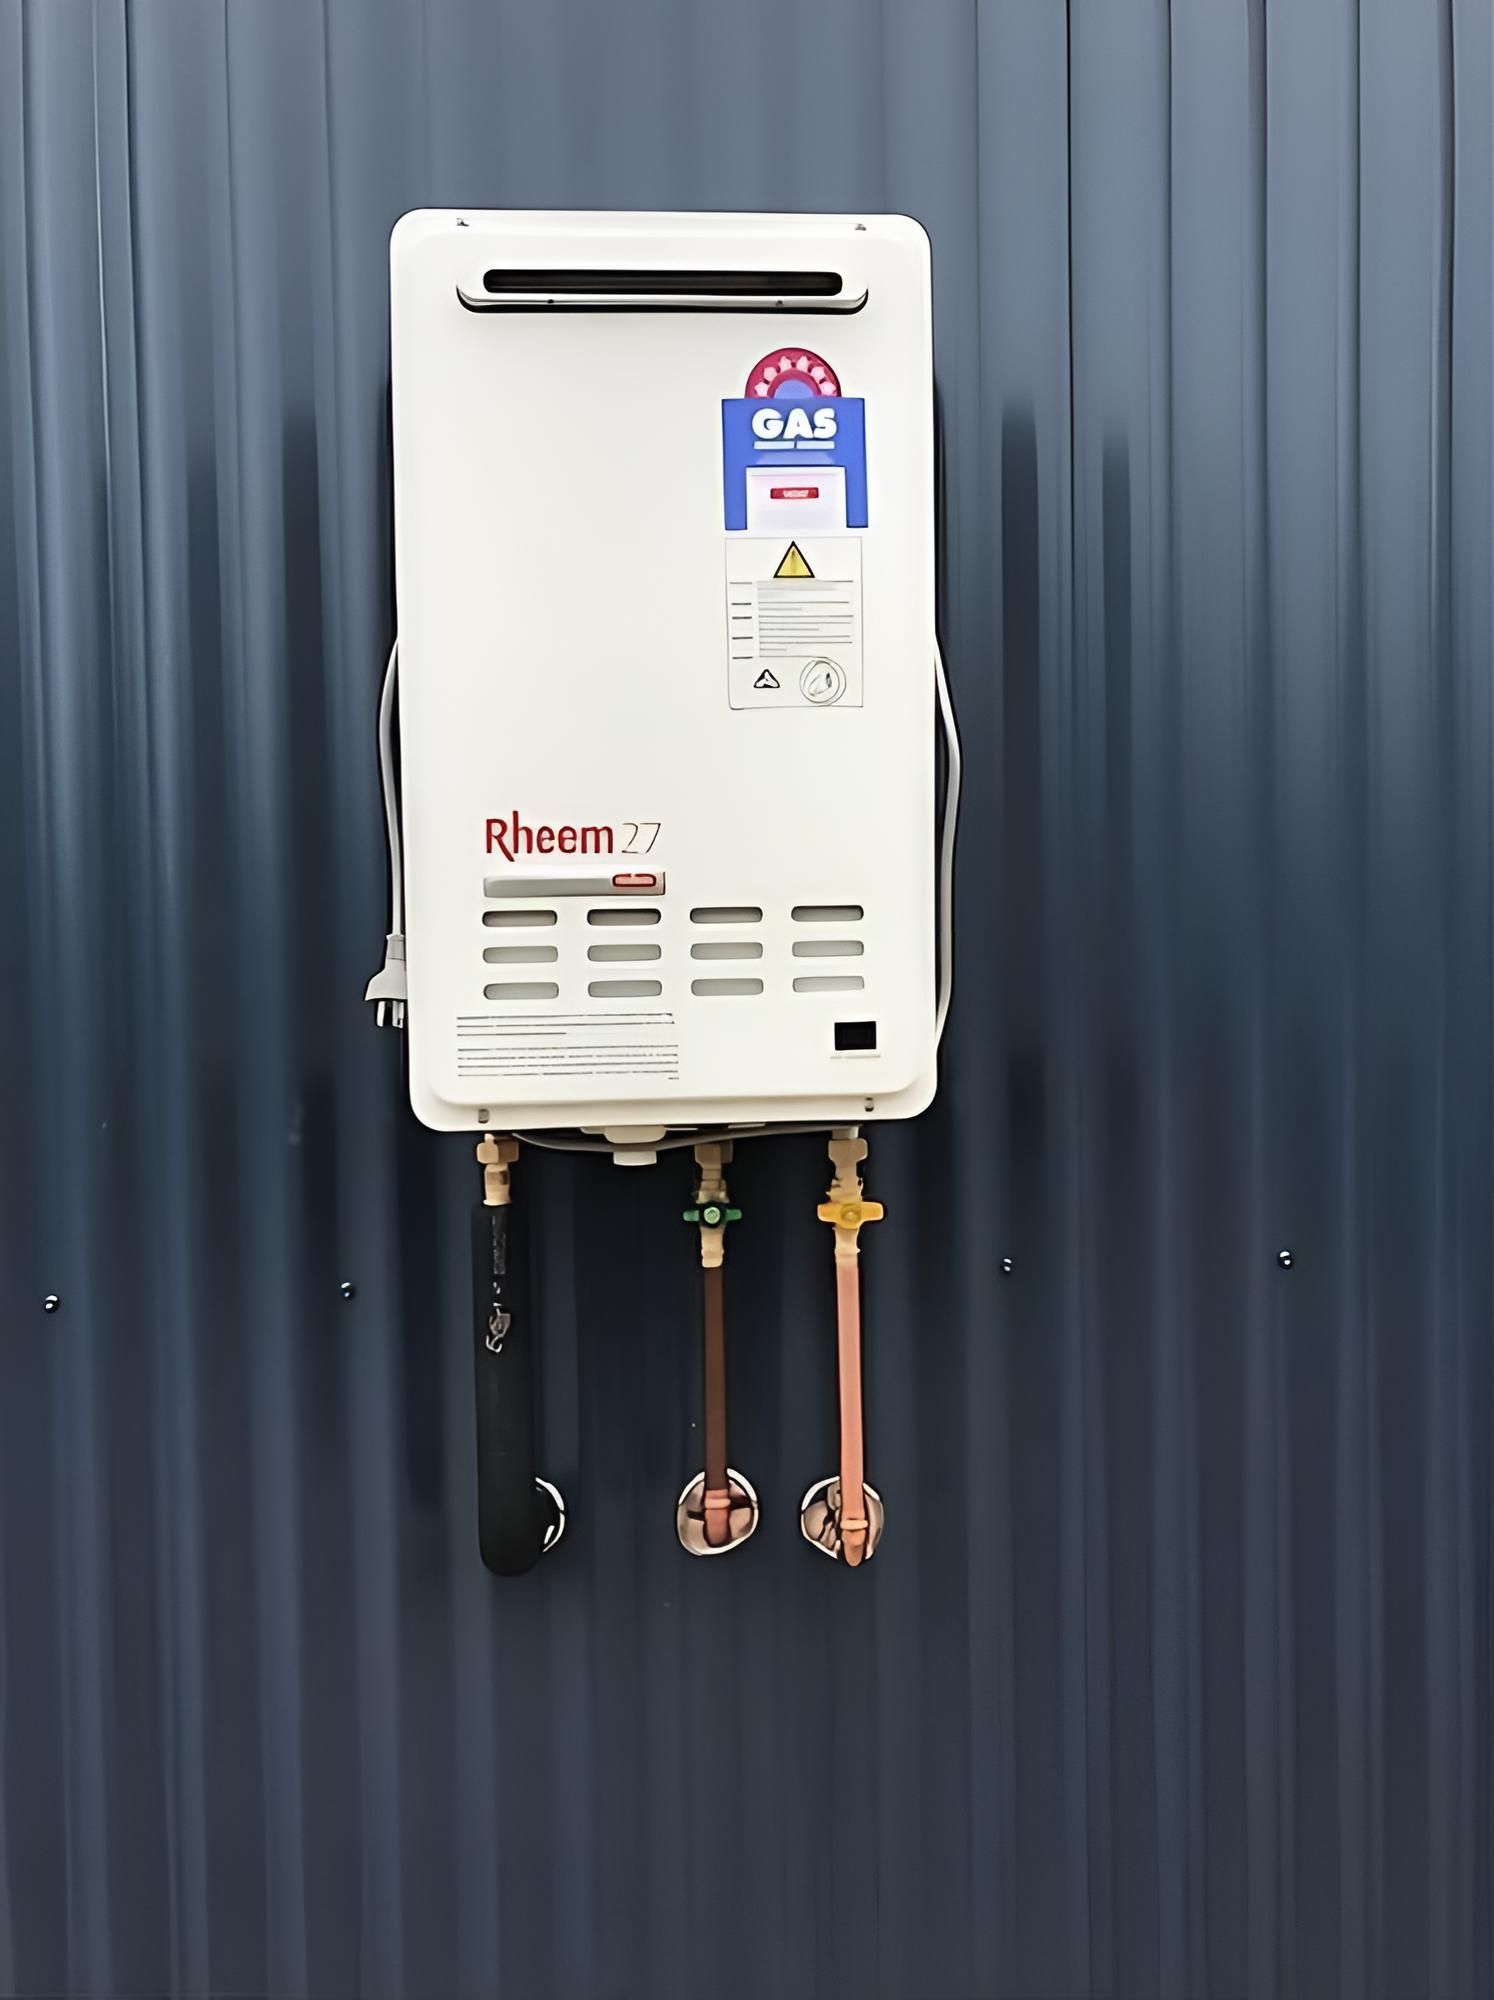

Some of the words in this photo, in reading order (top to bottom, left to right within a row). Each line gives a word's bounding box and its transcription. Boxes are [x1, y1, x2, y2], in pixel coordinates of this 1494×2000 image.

[752, 408, 837, 439] GAS
[486, 810, 614, 862] Rheem
[621, 822, 661, 854] 27
